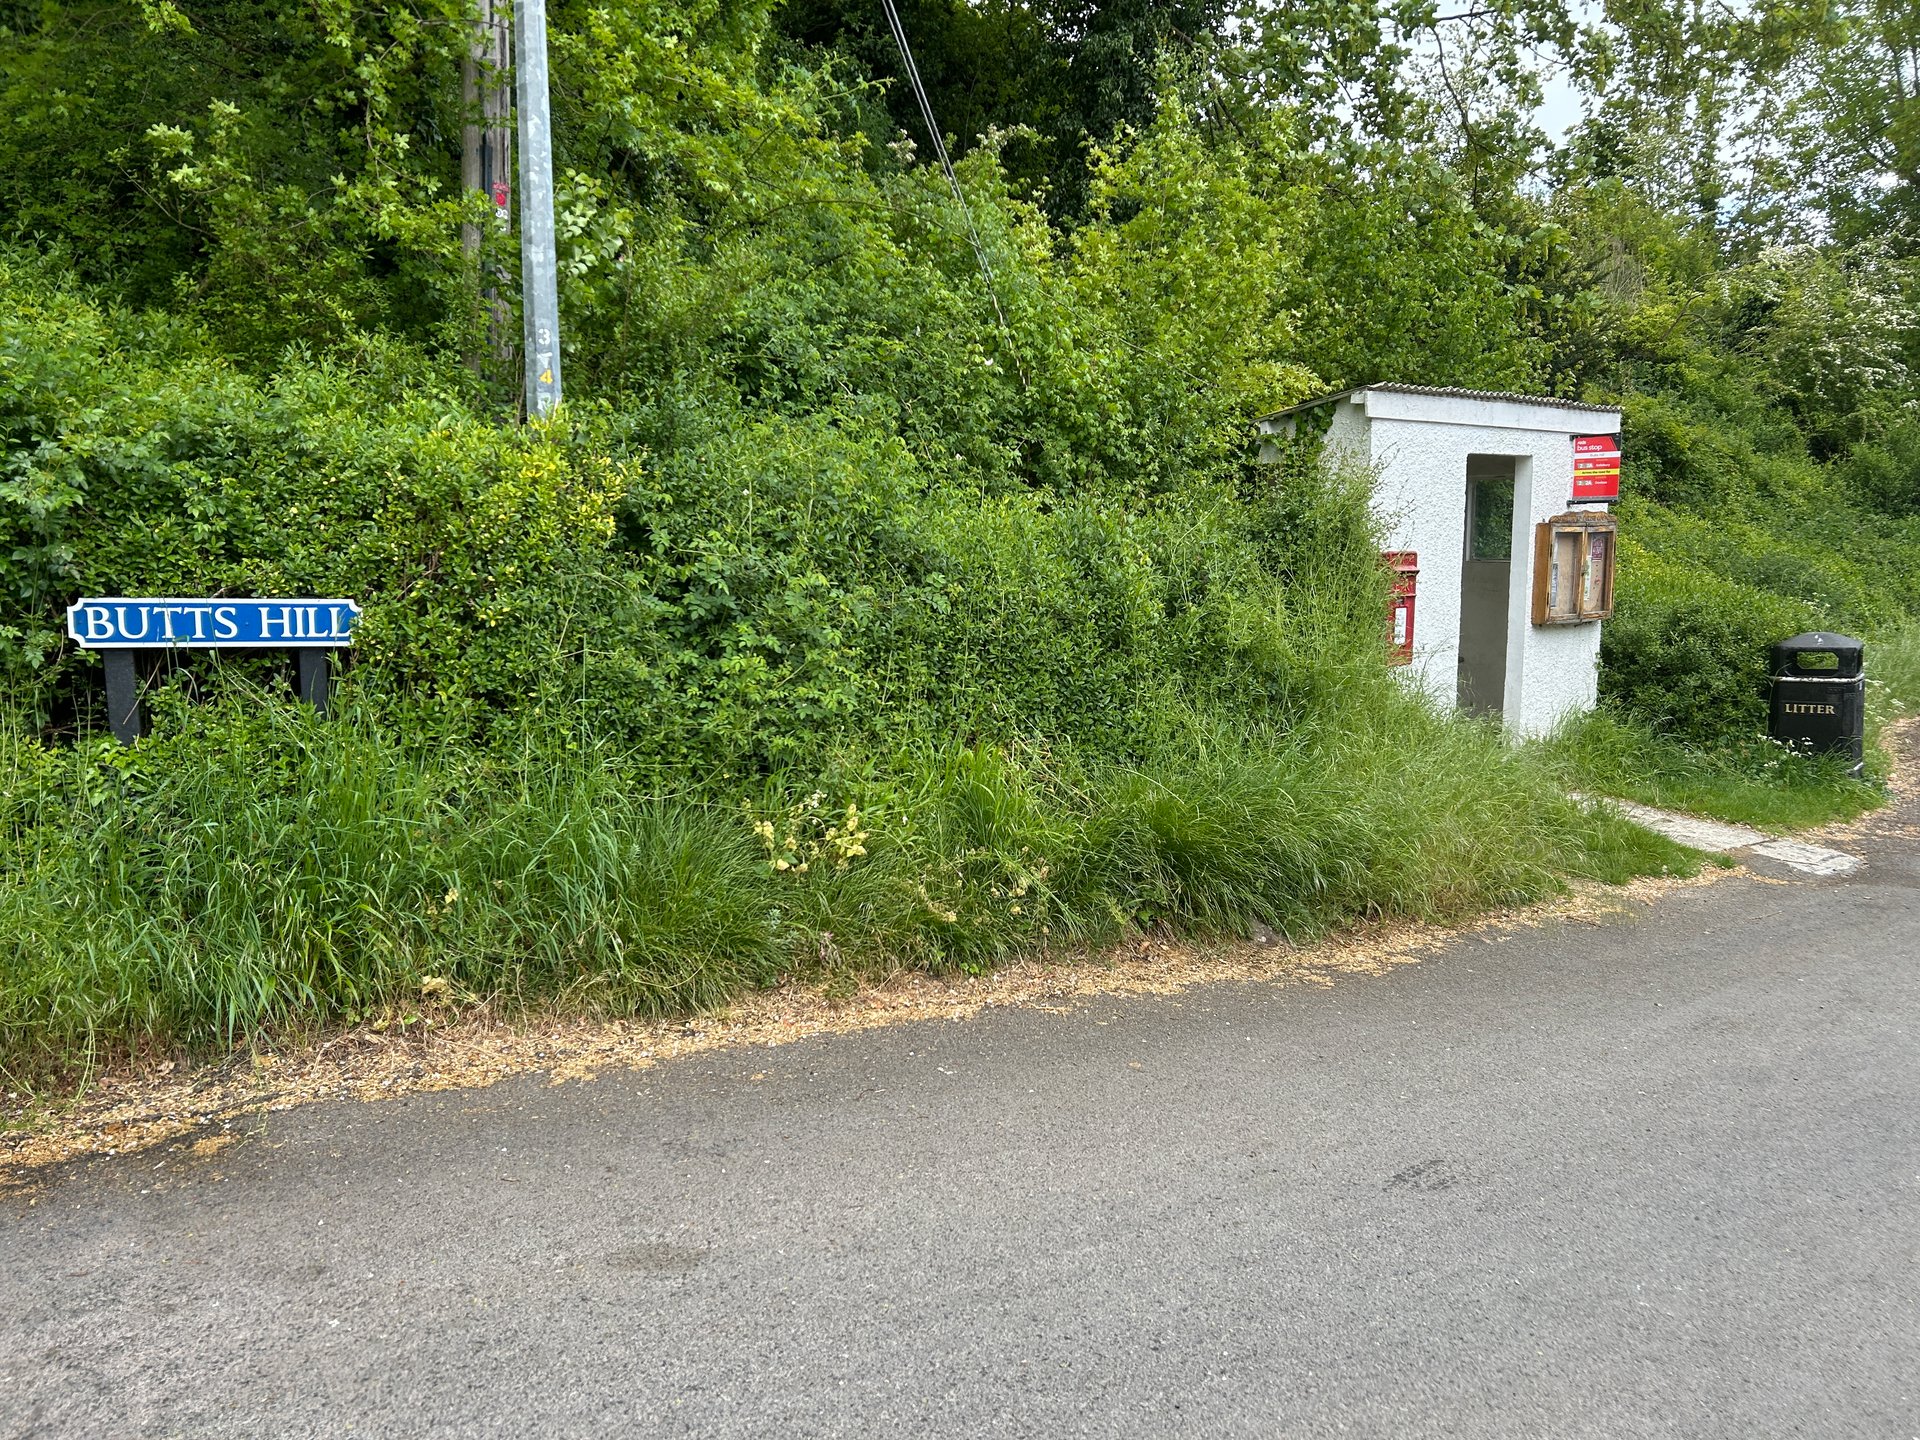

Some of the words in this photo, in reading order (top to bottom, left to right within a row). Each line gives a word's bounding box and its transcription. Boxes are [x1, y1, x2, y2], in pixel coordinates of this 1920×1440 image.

[538, 328, 551, 345] 3
[84, 606, 238, 639] BUTTS
[258, 606, 351, 638] HILL
[1785, 704, 1836, 714] LITTER
